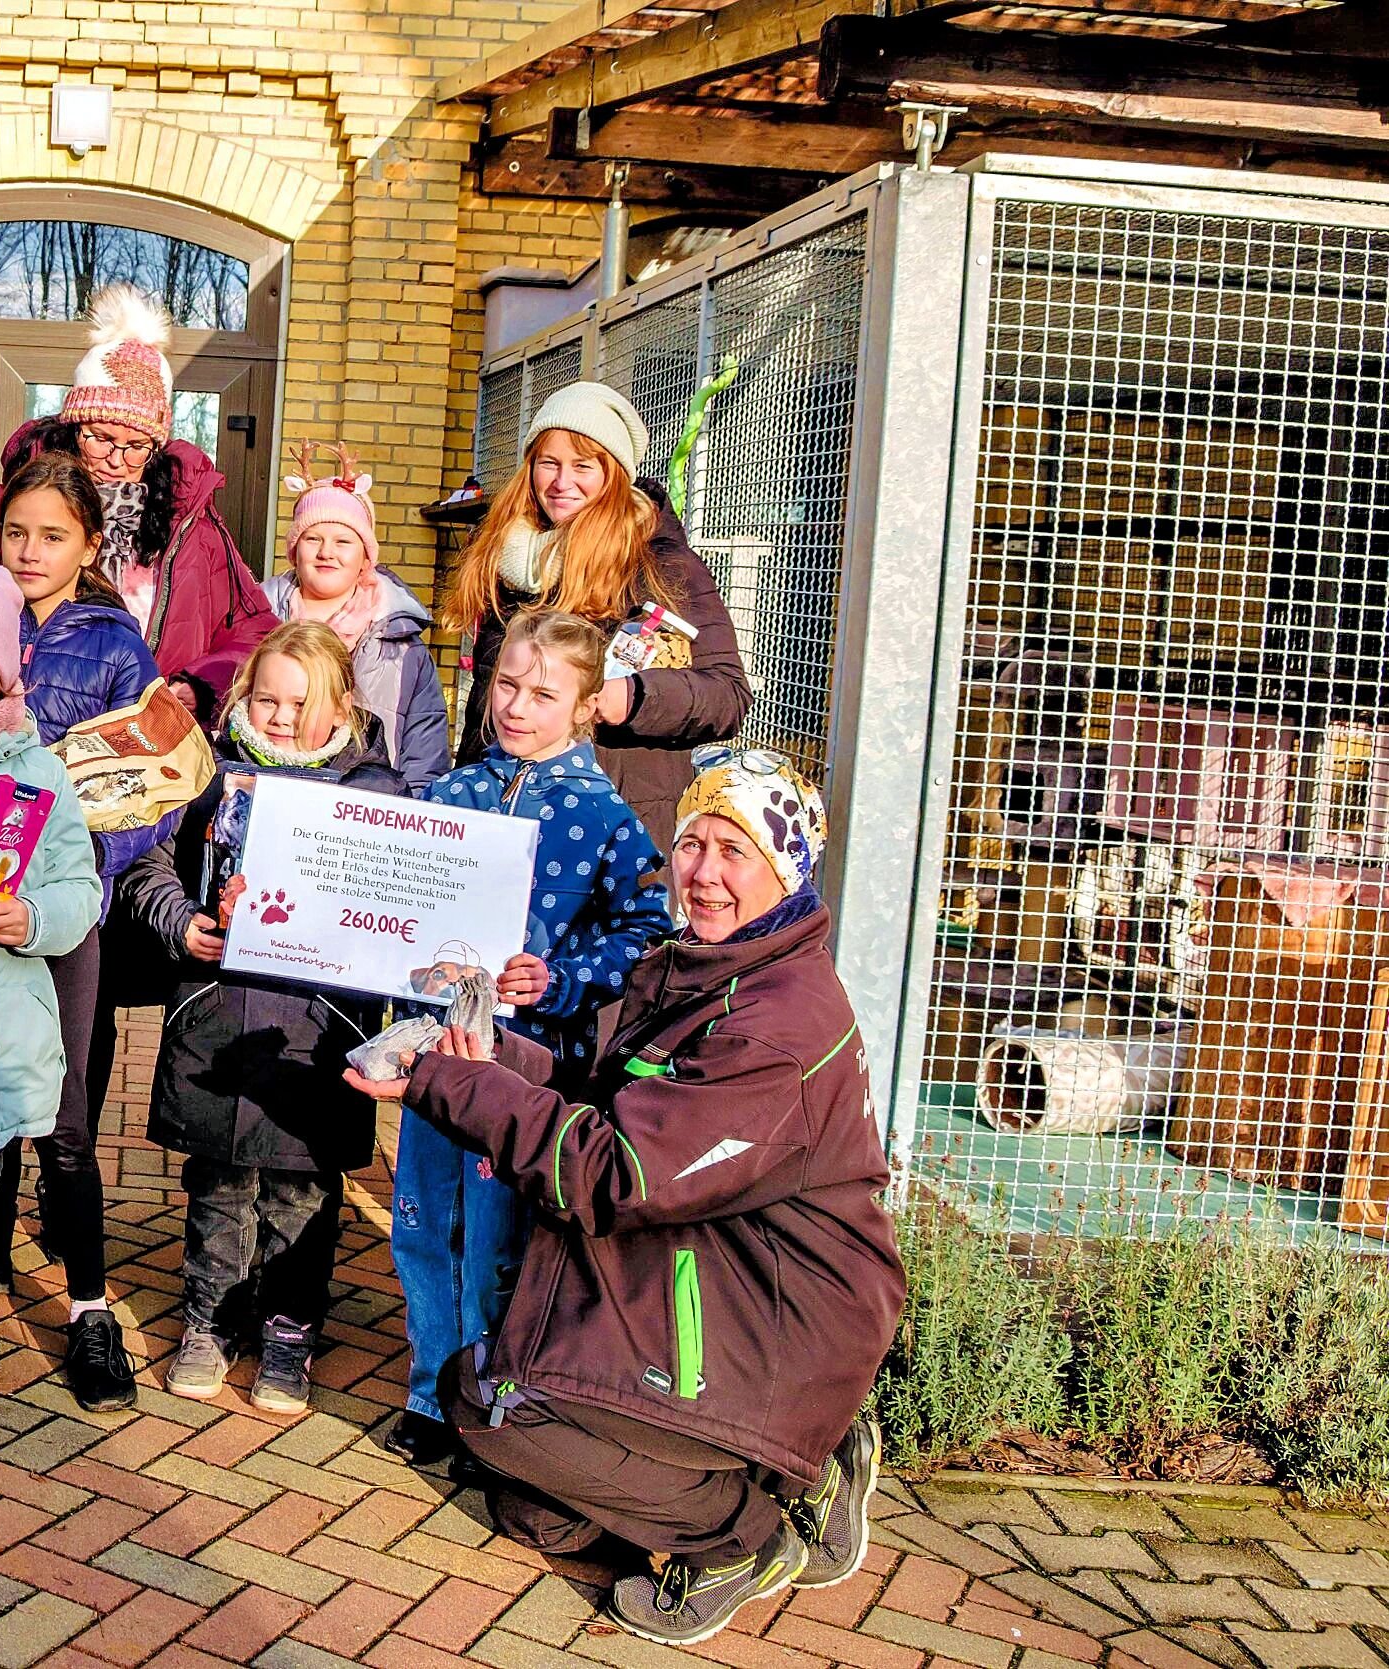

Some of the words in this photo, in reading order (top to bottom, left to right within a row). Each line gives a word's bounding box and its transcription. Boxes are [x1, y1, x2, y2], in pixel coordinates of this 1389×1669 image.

[332, 801, 465, 841] SPENDENAKTION
[292, 827, 312, 839] Die
[314, 831, 382, 851] Grundschule
[384, 843, 433, 860] Abtsdorf
[435, 852, 480, 869] übergibt
[316, 844, 339, 856] dem
[342, 848, 389, 865] Tierheim
[393, 857, 451, 878] Wittenberg
[294, 855, 313, 865] aus
[315, 856, 338, 869] dem
[341, 860, 369, 874] Erlös
[371, 866, 389, 878] des
[392, 869, 466, 891] Kuchenbasars
[300, 868, 321, 878] und
[323, 870, 341, 881] der
[344, 873, 456, 902] Bücherspendenaktion
[316, 881, 339, 894] eine
[340, 886, 371, 900] stolze
[373, 891, 414, 907] Summe
[416, 902, 436, 911] von
[339, 908, 420, 944] 260,00€
[270, 939, 298, 951] Vielen
[298, 943, 321, 954] Dank
